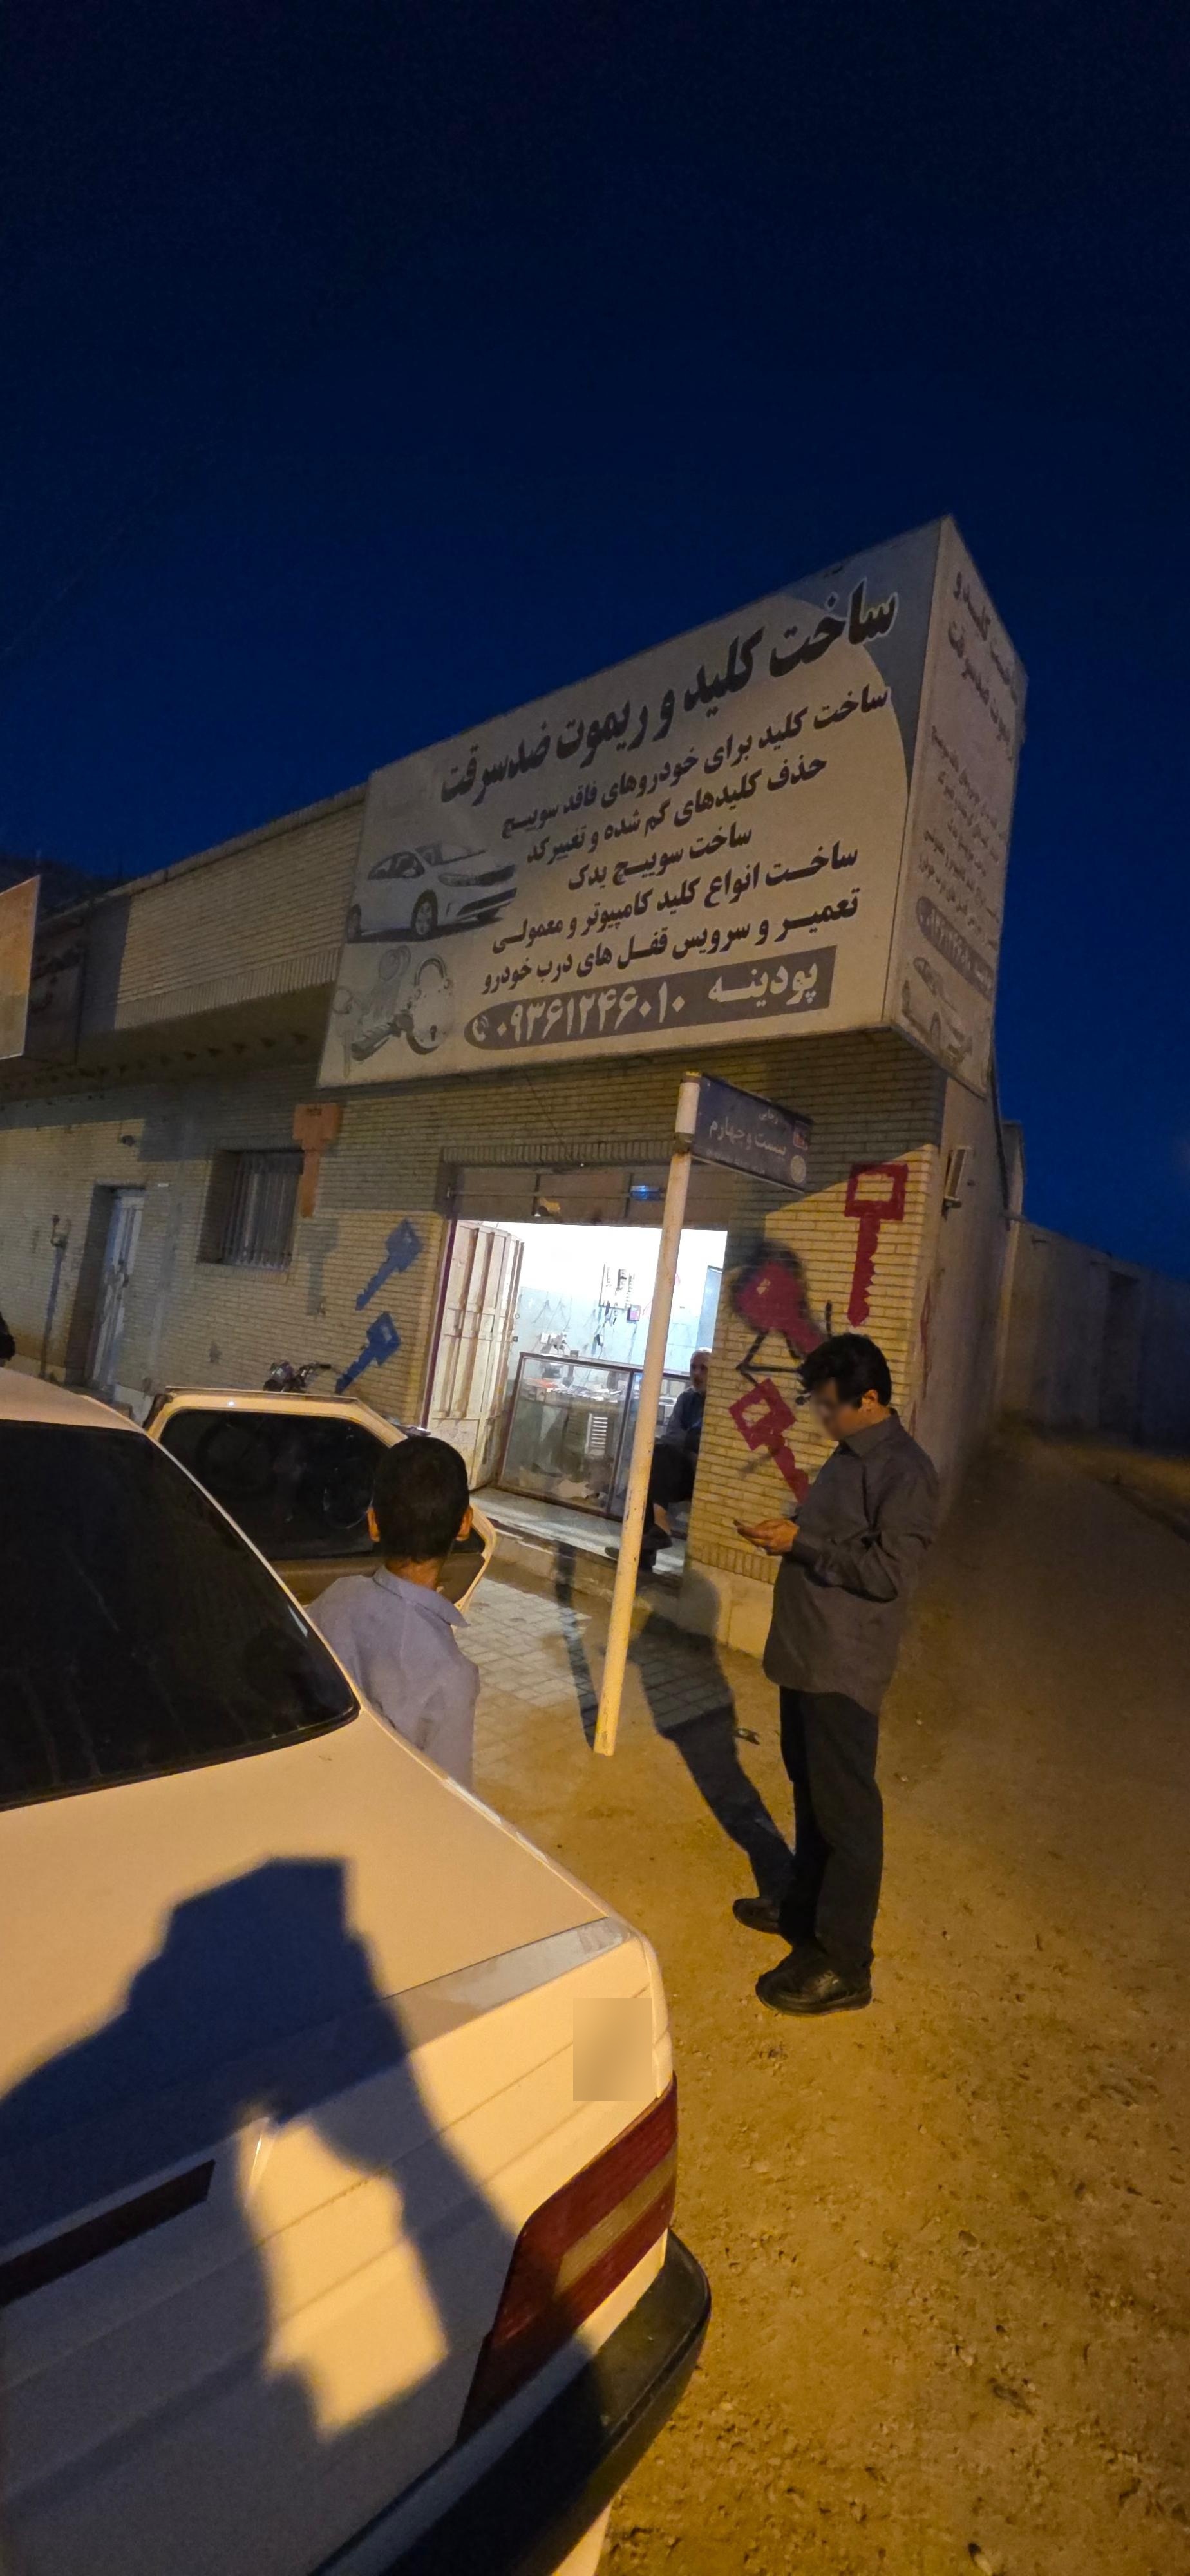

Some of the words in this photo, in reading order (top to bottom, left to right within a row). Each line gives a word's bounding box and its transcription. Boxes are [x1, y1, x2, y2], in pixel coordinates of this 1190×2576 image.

[770, 577, 898, 677] ساخت
[683, 625, 765, 717] کلید
[651, 689, 675, 741] و
[813, 683, 888, 729] ساخت
[556, 699, 648, 768] ریموت
[758, 707, 809, 750] کلید
[704, 734, 752, 773] برای
[767, 755, 827, 791] حذف
[601, 747, 699, 808] خودروهای
[563, 781, 598, 814] فاقد
[674, 768, 763, 827] کلیدهای
[587, 831, 599, 853] و
[604, 809, 641, 840] شده
[689, 822, 752, 859] ساخت
[527, 837, 550, 864] کد
[547, 825, 587, 865] تغییر
[765, 840, 858, 886] ساخت
[568, 864, 607, 891] یدک
[657, 876, 701, 915] کلید
[704, 862, 760, 908] انواع
[565, 916, 578, 939] و
[580, 887, 654, 936] کامپیوتر
[774, 887, 860, 942] تعمیر
[492, 918, 563, 954] معمولی
[617, 927, 668, 970] قفل
[672, 923, 751, 960] سرویس
[754, 919, 769, 945] و
[481, 957, 532, 995] خودرو
[536, 954, 572, 983] درب
[576, 942, 612, 978] های
[708, 963, 818, 1007] پودینه
[496, 981, 685, 1042] ۰۹۳۶۱۲۴۶۰۱۰
